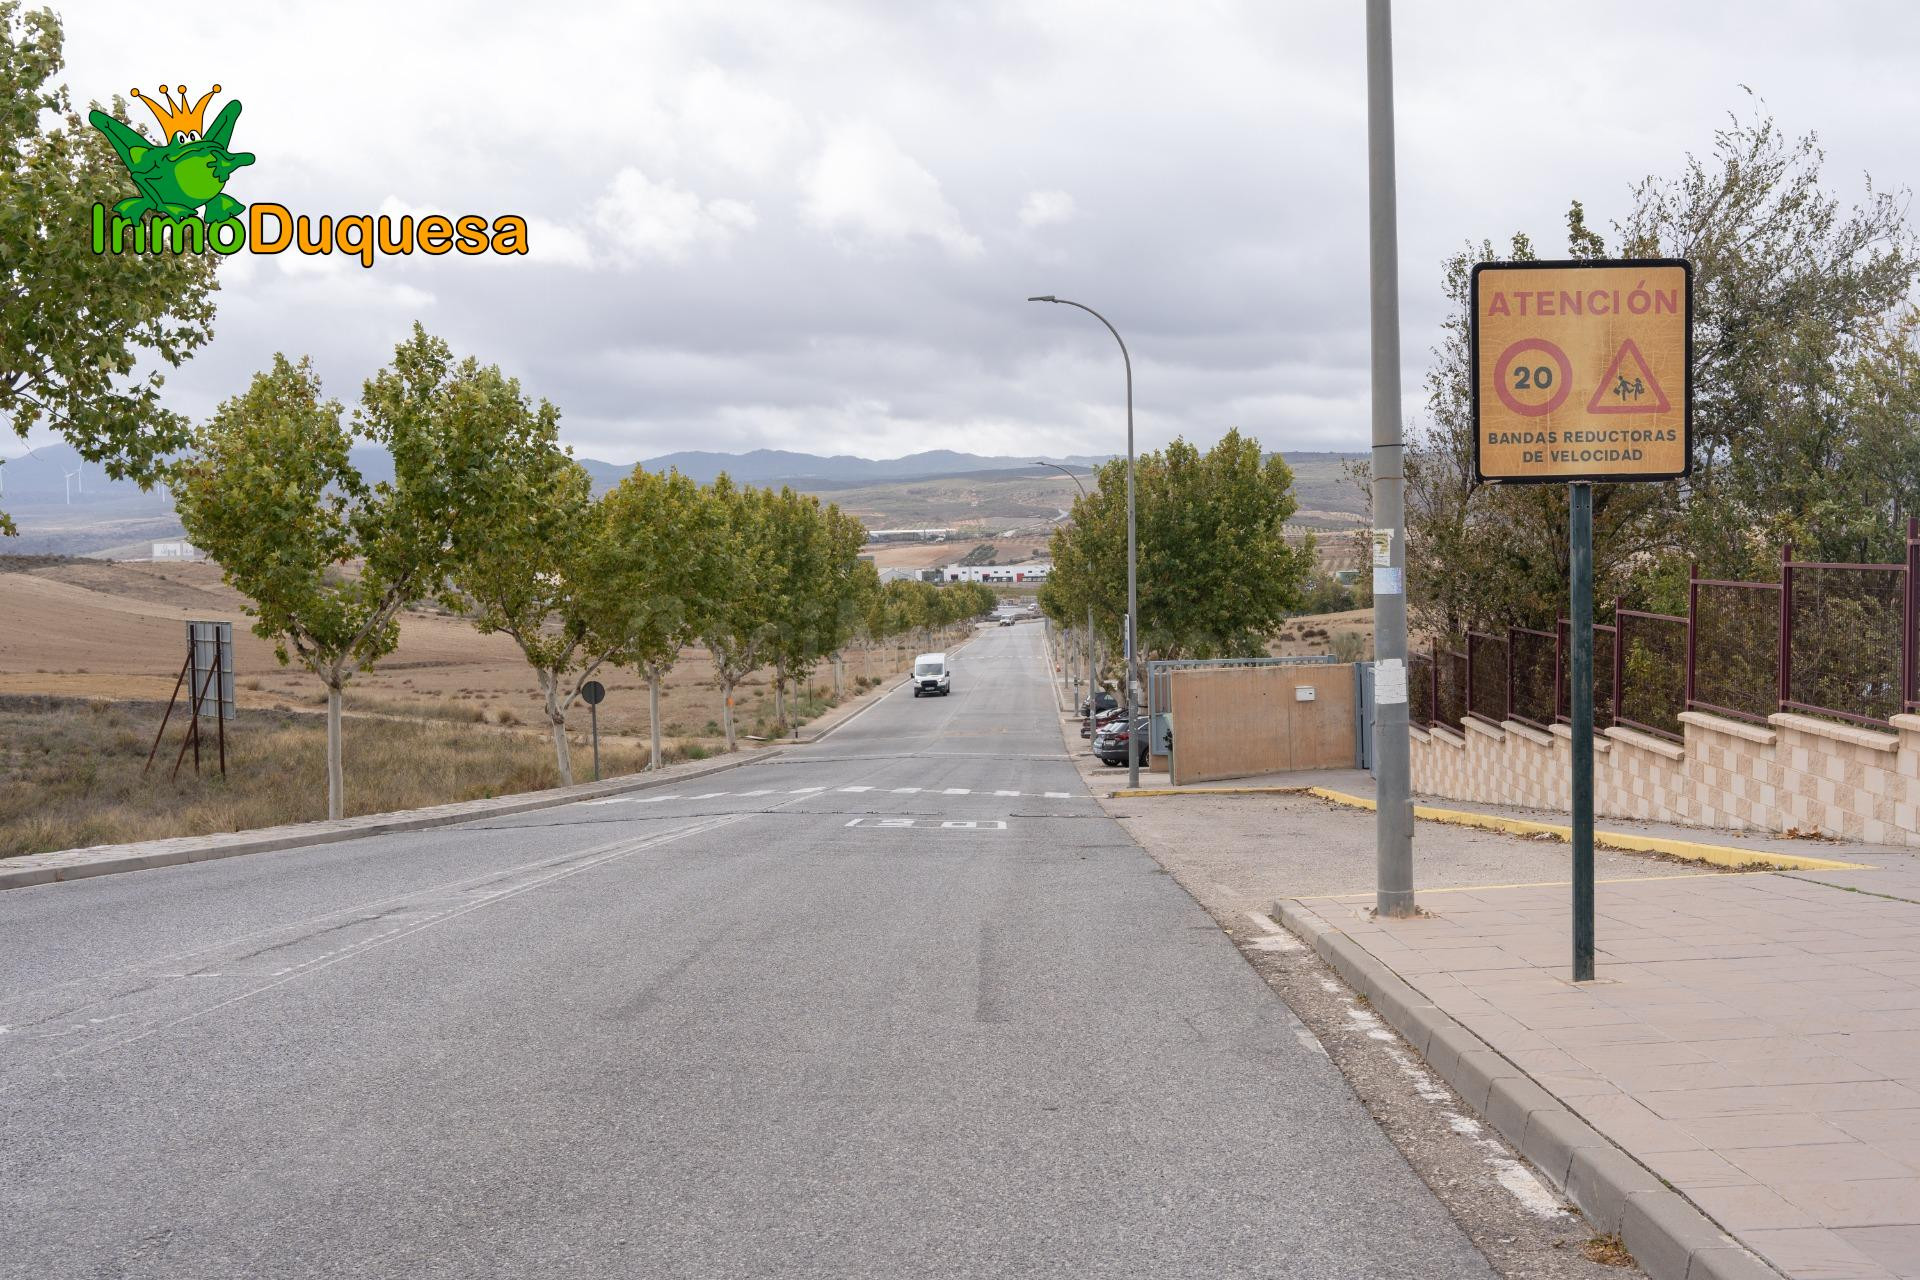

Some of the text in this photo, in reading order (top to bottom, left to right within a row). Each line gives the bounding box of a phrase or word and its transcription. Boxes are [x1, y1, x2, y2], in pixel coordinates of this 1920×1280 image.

[1487, 280, 1678, 317] ATENCIÓN
[1513, 366, 1553, 390] 20
[1488, 429, 1677, 445] BANDAS REDUCTORAS
[1522, 449, 1643, 463] DE VELOCIDAD
